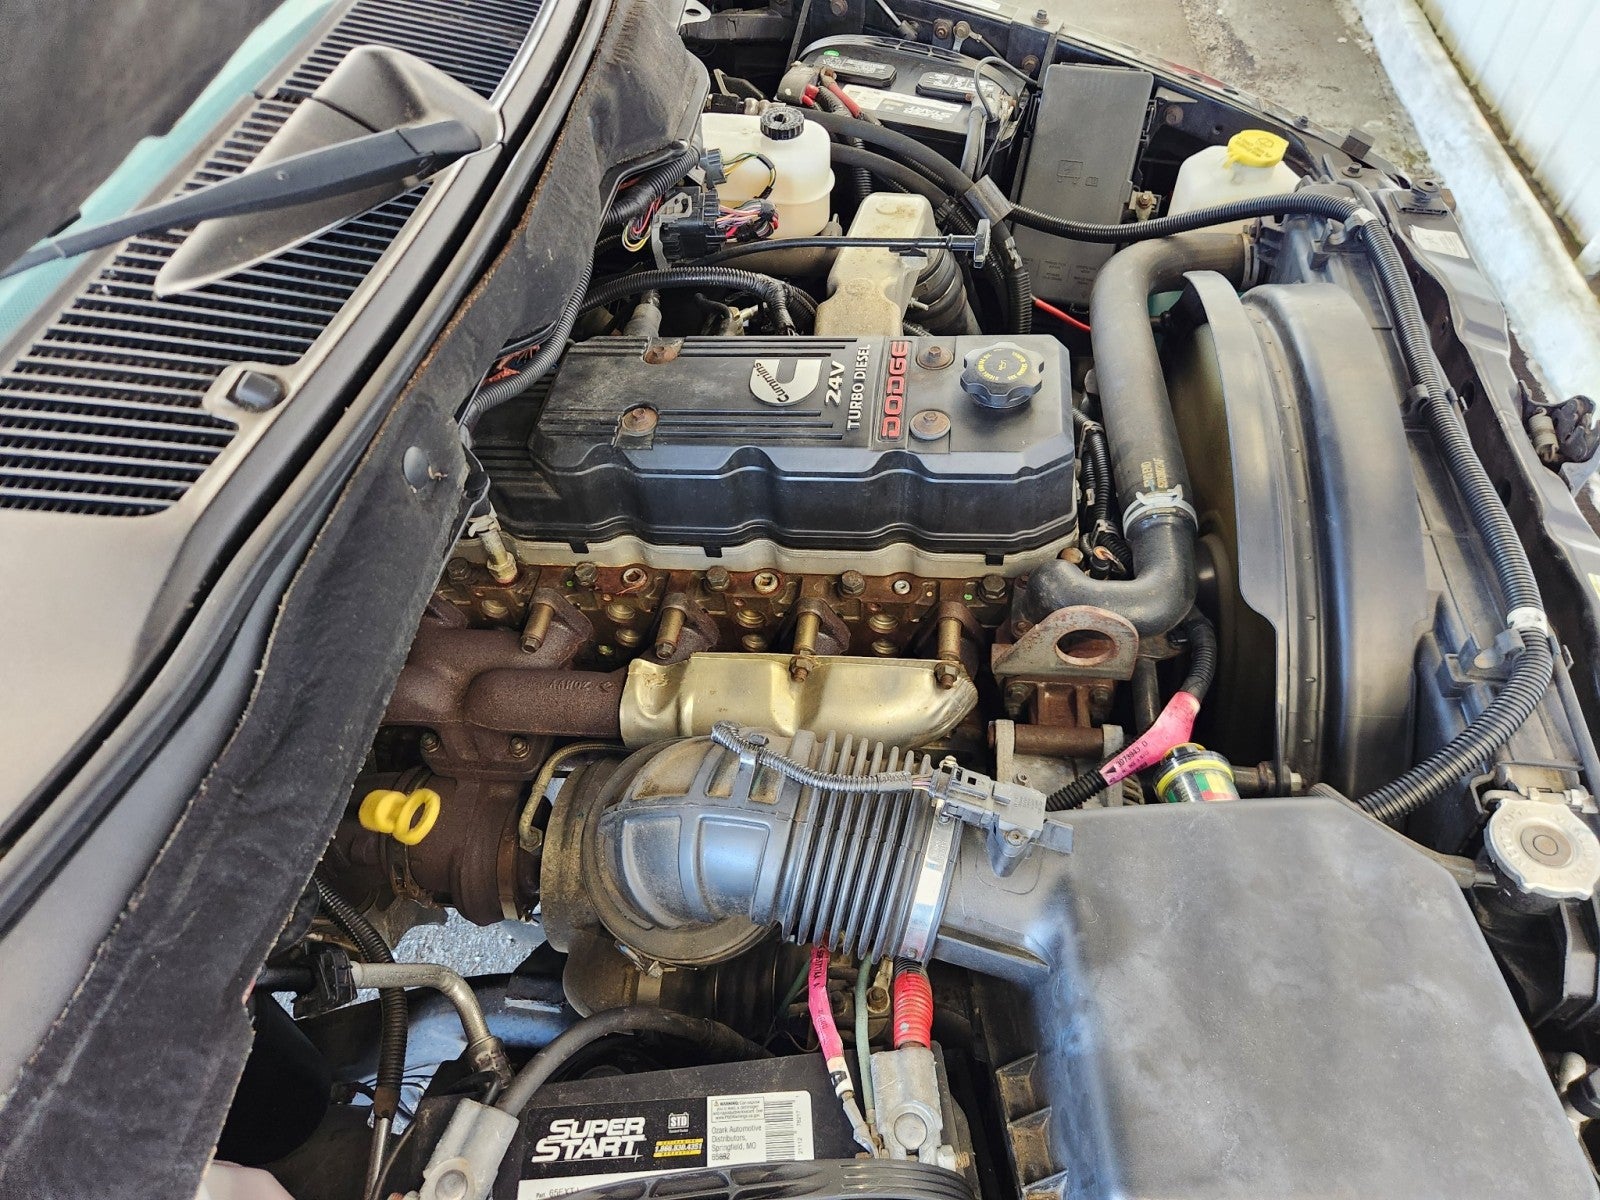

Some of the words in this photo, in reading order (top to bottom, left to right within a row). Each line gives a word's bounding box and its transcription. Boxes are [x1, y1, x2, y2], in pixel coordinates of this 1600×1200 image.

[854, 344, 871, 381] DIESEL
[755, 362, 790, 403] Cummins
[824, 360, 846, 408] 24V
[881, 341, 908, 439] DODGE
[847, 382, 865, 431] TURBO
[548, 1117, 646, 1141] SUPER
[670, 1116, 688, 1127] STD
[711, 1126, 727, 1134] Ozark
[729, 1124, 762, 1133] Automotive
[531, 1134, 647, 1163] START
[746, 1141, 757, 1149] MO
